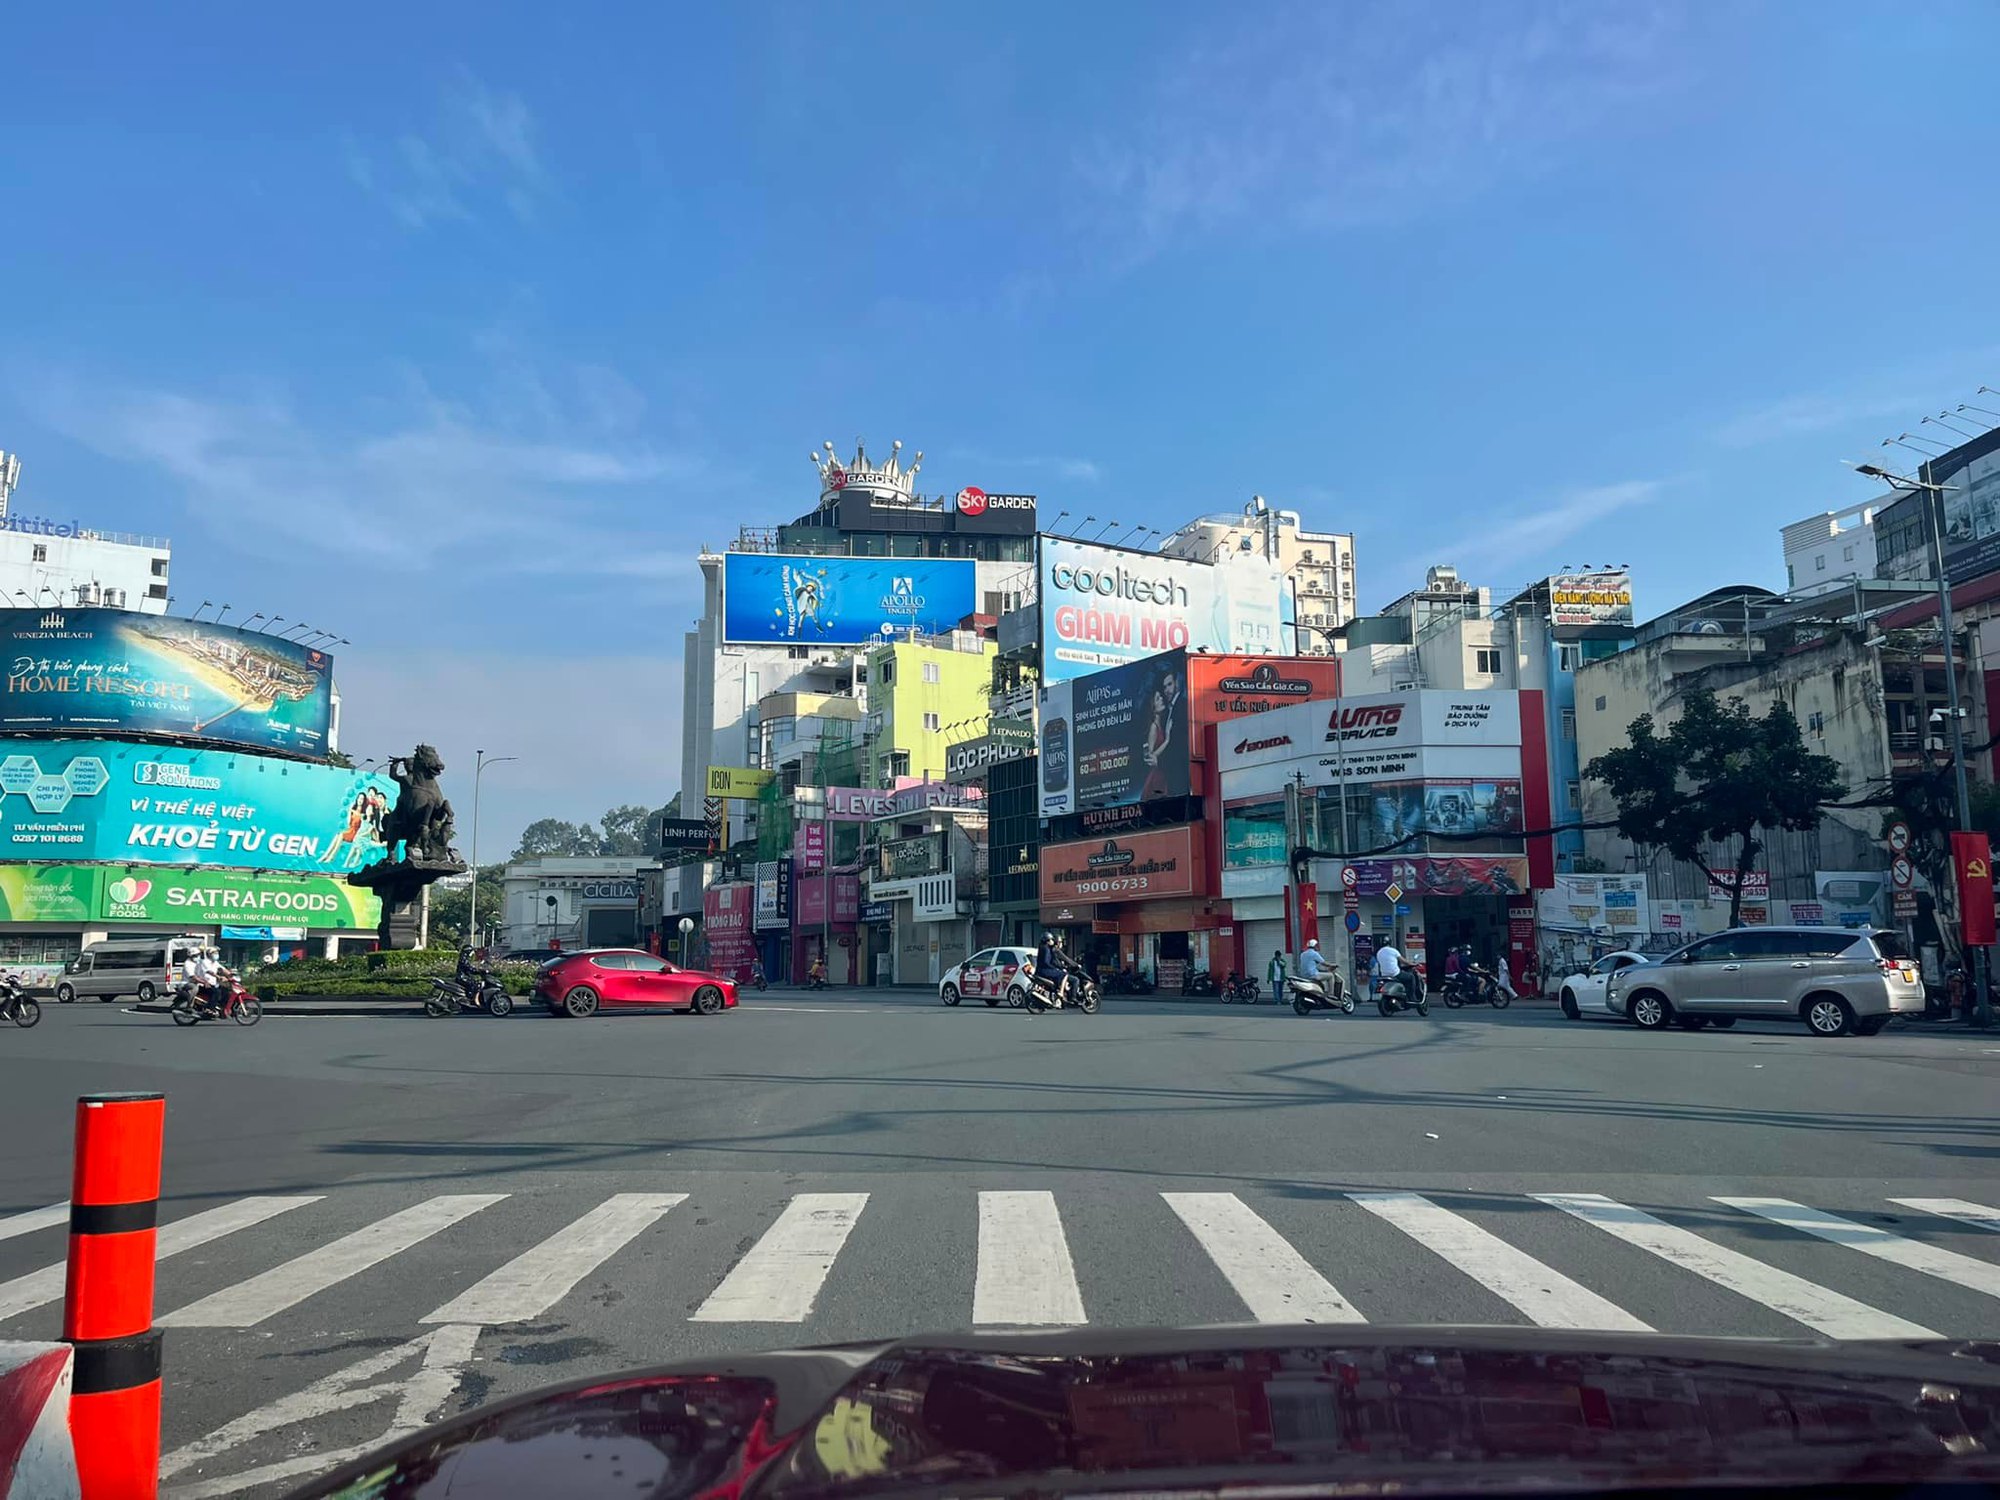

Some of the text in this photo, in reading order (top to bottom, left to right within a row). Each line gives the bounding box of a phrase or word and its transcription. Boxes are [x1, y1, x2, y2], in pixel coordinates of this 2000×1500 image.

[847, 474, 900, 487] GARDEN
[957, 490, 1037, 509] SKY GARDEN
[1053, 560, 1188, 607] cooltech
[881, 595, 926, 606] APOLLO
[8, 676, 192, 700] HOME RESORT
[993, 728, 1031, 738] LEONARDO
[1247, 735, 1293, 752] HONDA
[947, 747, 976, 775] LỘC
[1356, 765, 1378, 775] SƠN
[1381, 763, 1405, 773] MINH
[161, 765, 189, 775] GENE
[160, 774, 220, 789] SOLUTIONS
[711, 770, 731, 790] ICON
[130, 797, 256, 820] VÌ THẾ HỆ VIỆT
[850, 795, 897, 817] EYES
[227, 827, 265, 851] TỪ
[268, 833, 319, 855] GEN
[665, 827, 720, 839] LINH PERFUM
[1008, 862, 1039, 875] LEONARDO
[584, 882, 636, 898] CICILIA
[780, 863, 788, 913] HOTEL
[1076, 877, 1149, 893] 1900 6733
[109, 903, 146, 911] SATRA
[166, 887, 338, 912] SATRAFOODS
